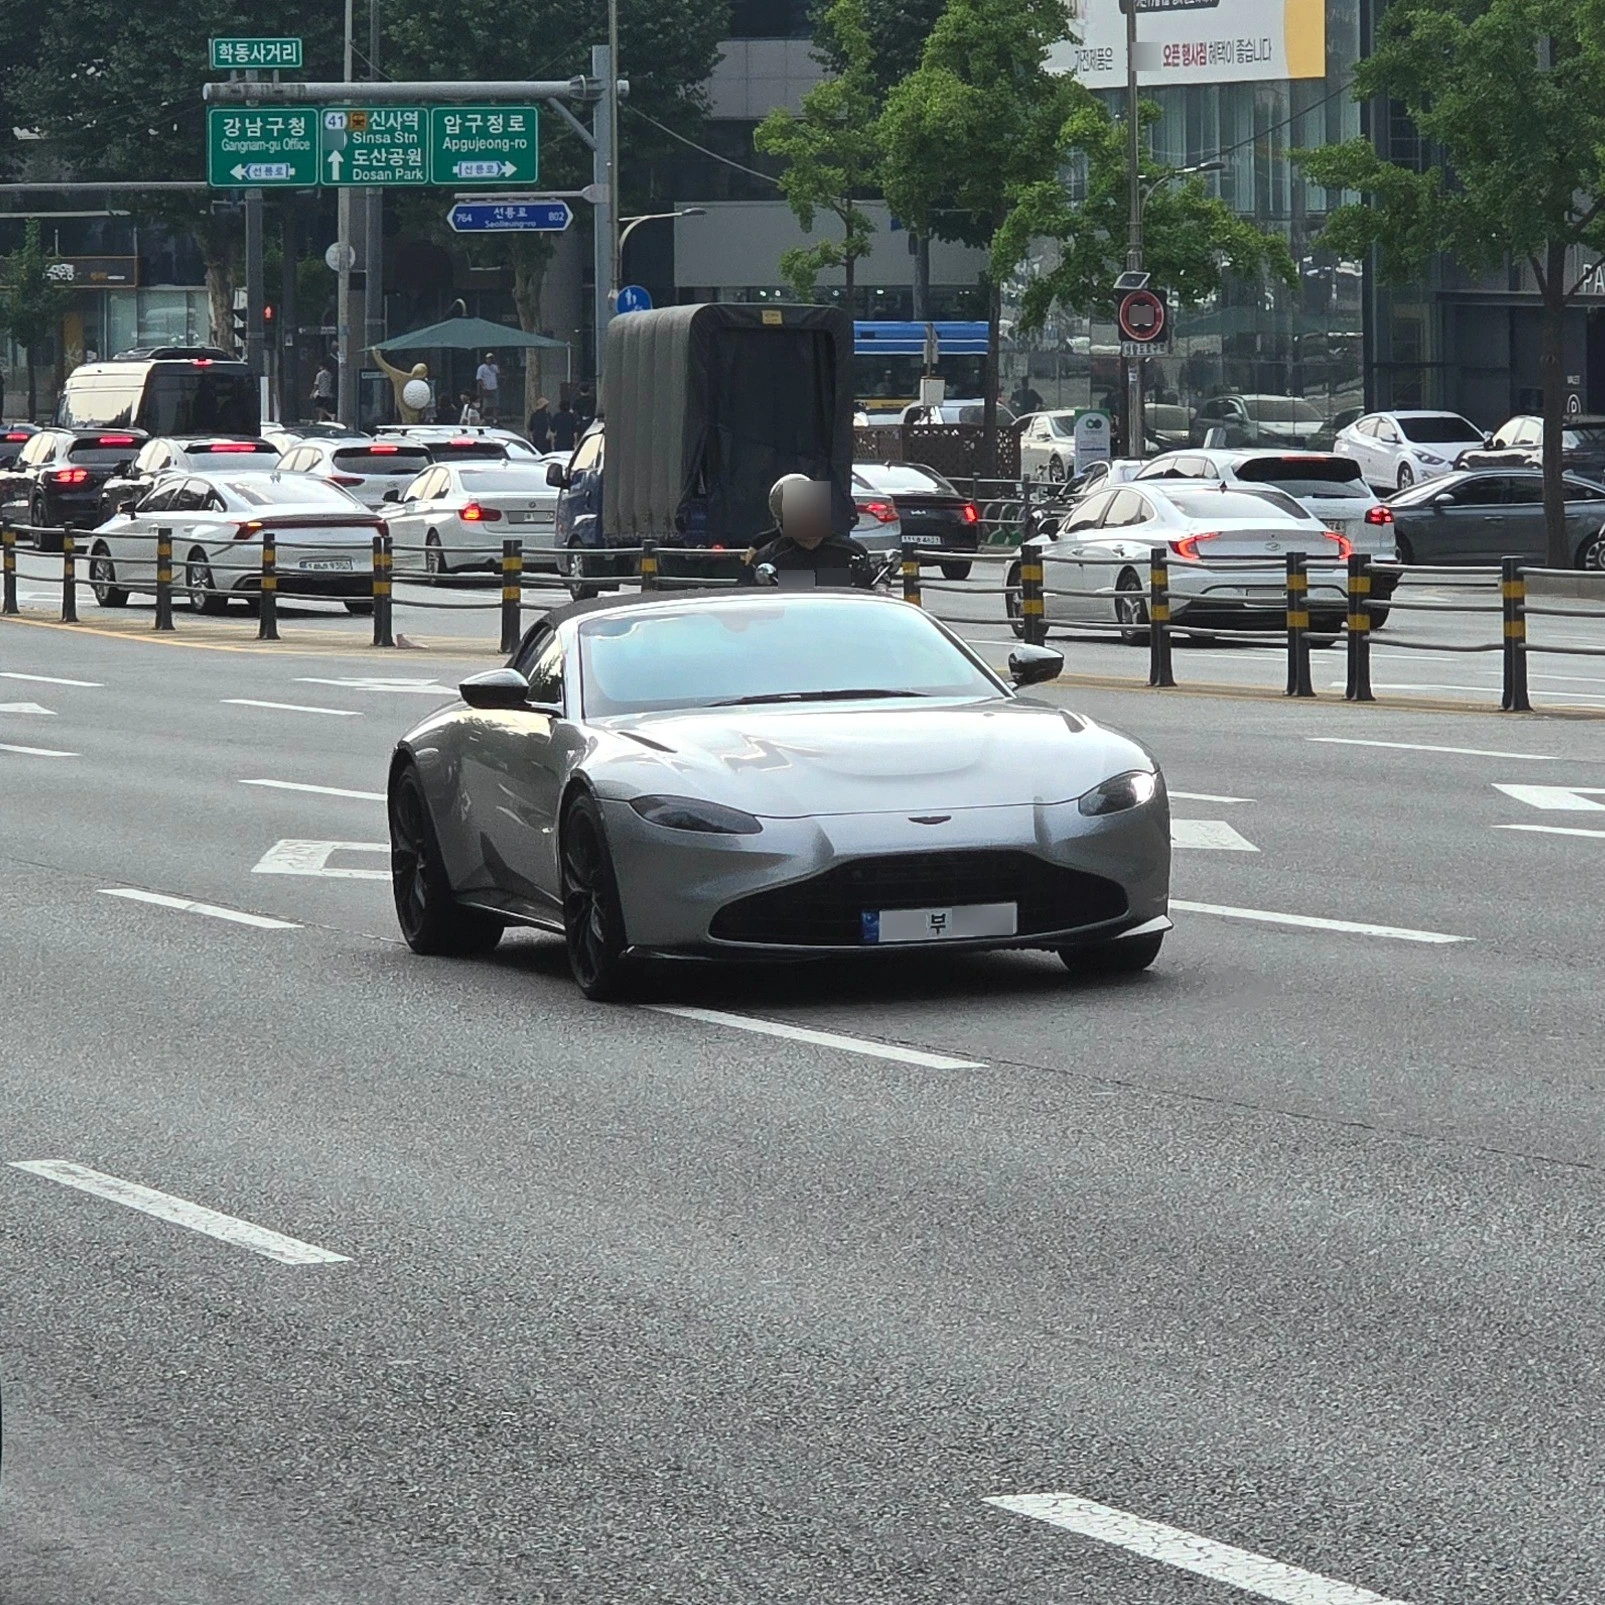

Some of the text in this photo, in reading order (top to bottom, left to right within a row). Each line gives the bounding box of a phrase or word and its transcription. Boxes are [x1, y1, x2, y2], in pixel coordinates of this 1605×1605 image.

[219, 42, 296, 63] 학동사거리
[1163, 44, 1180, 67] 오픈
[1181, 42, 1207, 67] 행사점
[1236, 37, 1271, 63] 좋습니다
[223, 117, 305, 137] 강남구청
[328, 115, 344, 128] 41
[369, 110, 418, 131] 신사역
[443, 113, 526, 134] 압구정로
[221, 138, 311, 153] Gangnam-gu Office
[352, 131, 418, 144] Sinsa Stn
[442, 136, 527, 152] Apgujeong-ro
[352, 147, 422, 166] 도산공원
[352, 168, 424, 181] Dosan Park
[456, 212, 472, 223] 764
[493, 206, 528, 219] 선릉로
[547, 211, 564, 222] 802
[930, 913, 946, 935] 부
